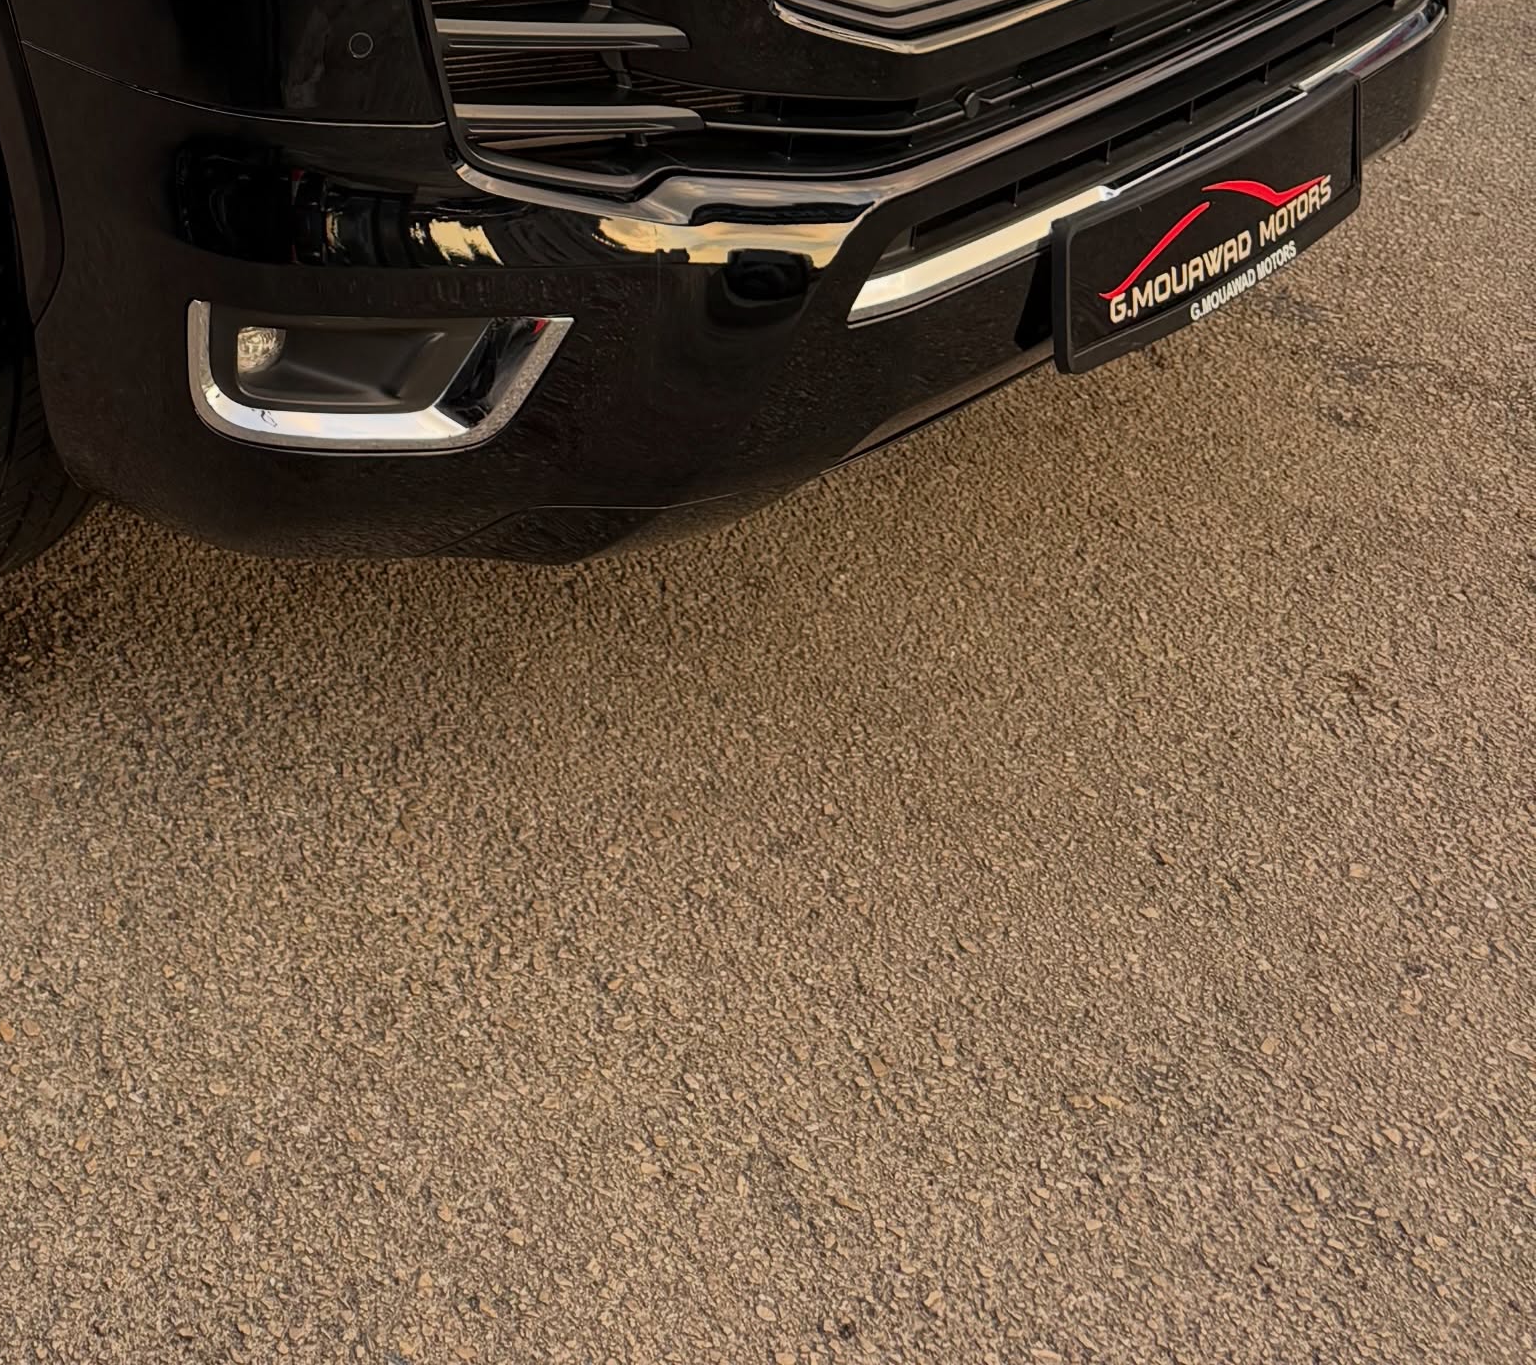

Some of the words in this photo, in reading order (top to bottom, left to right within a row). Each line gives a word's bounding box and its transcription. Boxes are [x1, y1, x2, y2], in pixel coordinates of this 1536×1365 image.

[1109, 228, 1253, 324] G.MOUAWAD
[1258, 174, 1332, 249] MOTORS
[1190, 267, 1257, 322] G.MOUAWAD
[1256, 240, 1298, 281] MOTORS
